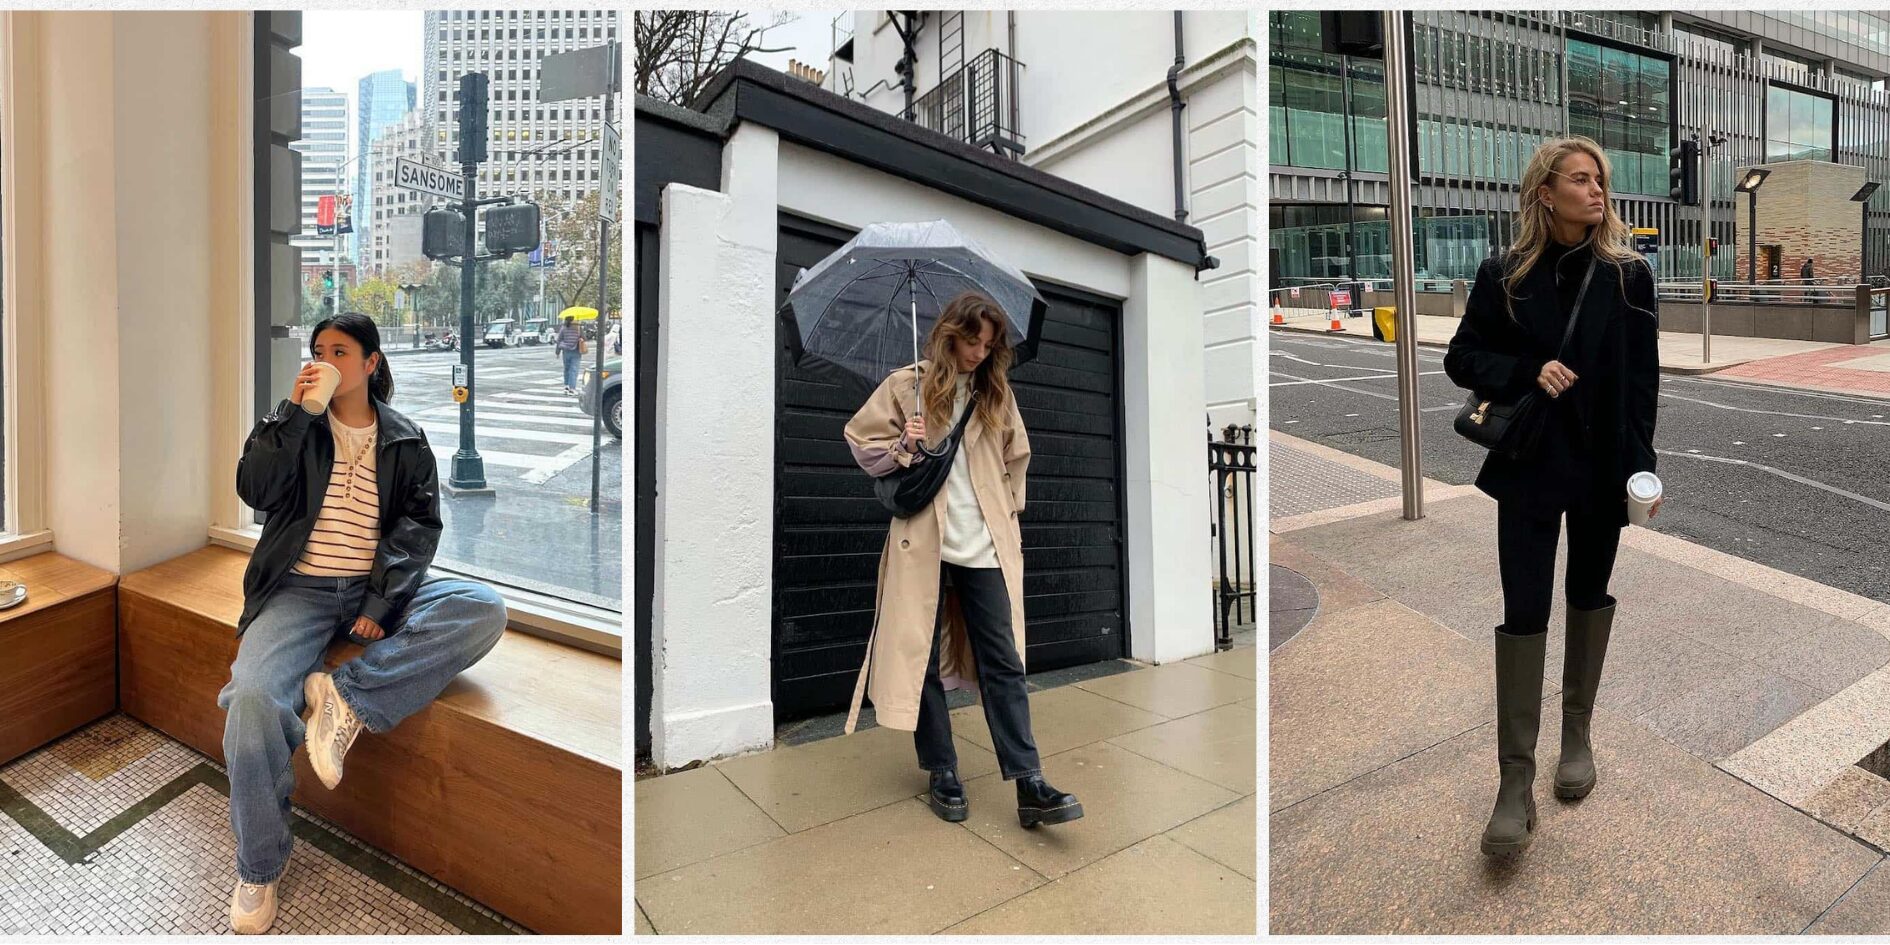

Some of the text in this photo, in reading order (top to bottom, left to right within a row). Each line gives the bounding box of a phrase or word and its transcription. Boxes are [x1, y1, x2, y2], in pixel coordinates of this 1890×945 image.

[608, 134, 617, 156] NO
[401, 165, 463, 196] SANSOME
[1773, 265, 1778, 273] 2
[324, 702, 334, 717] N
